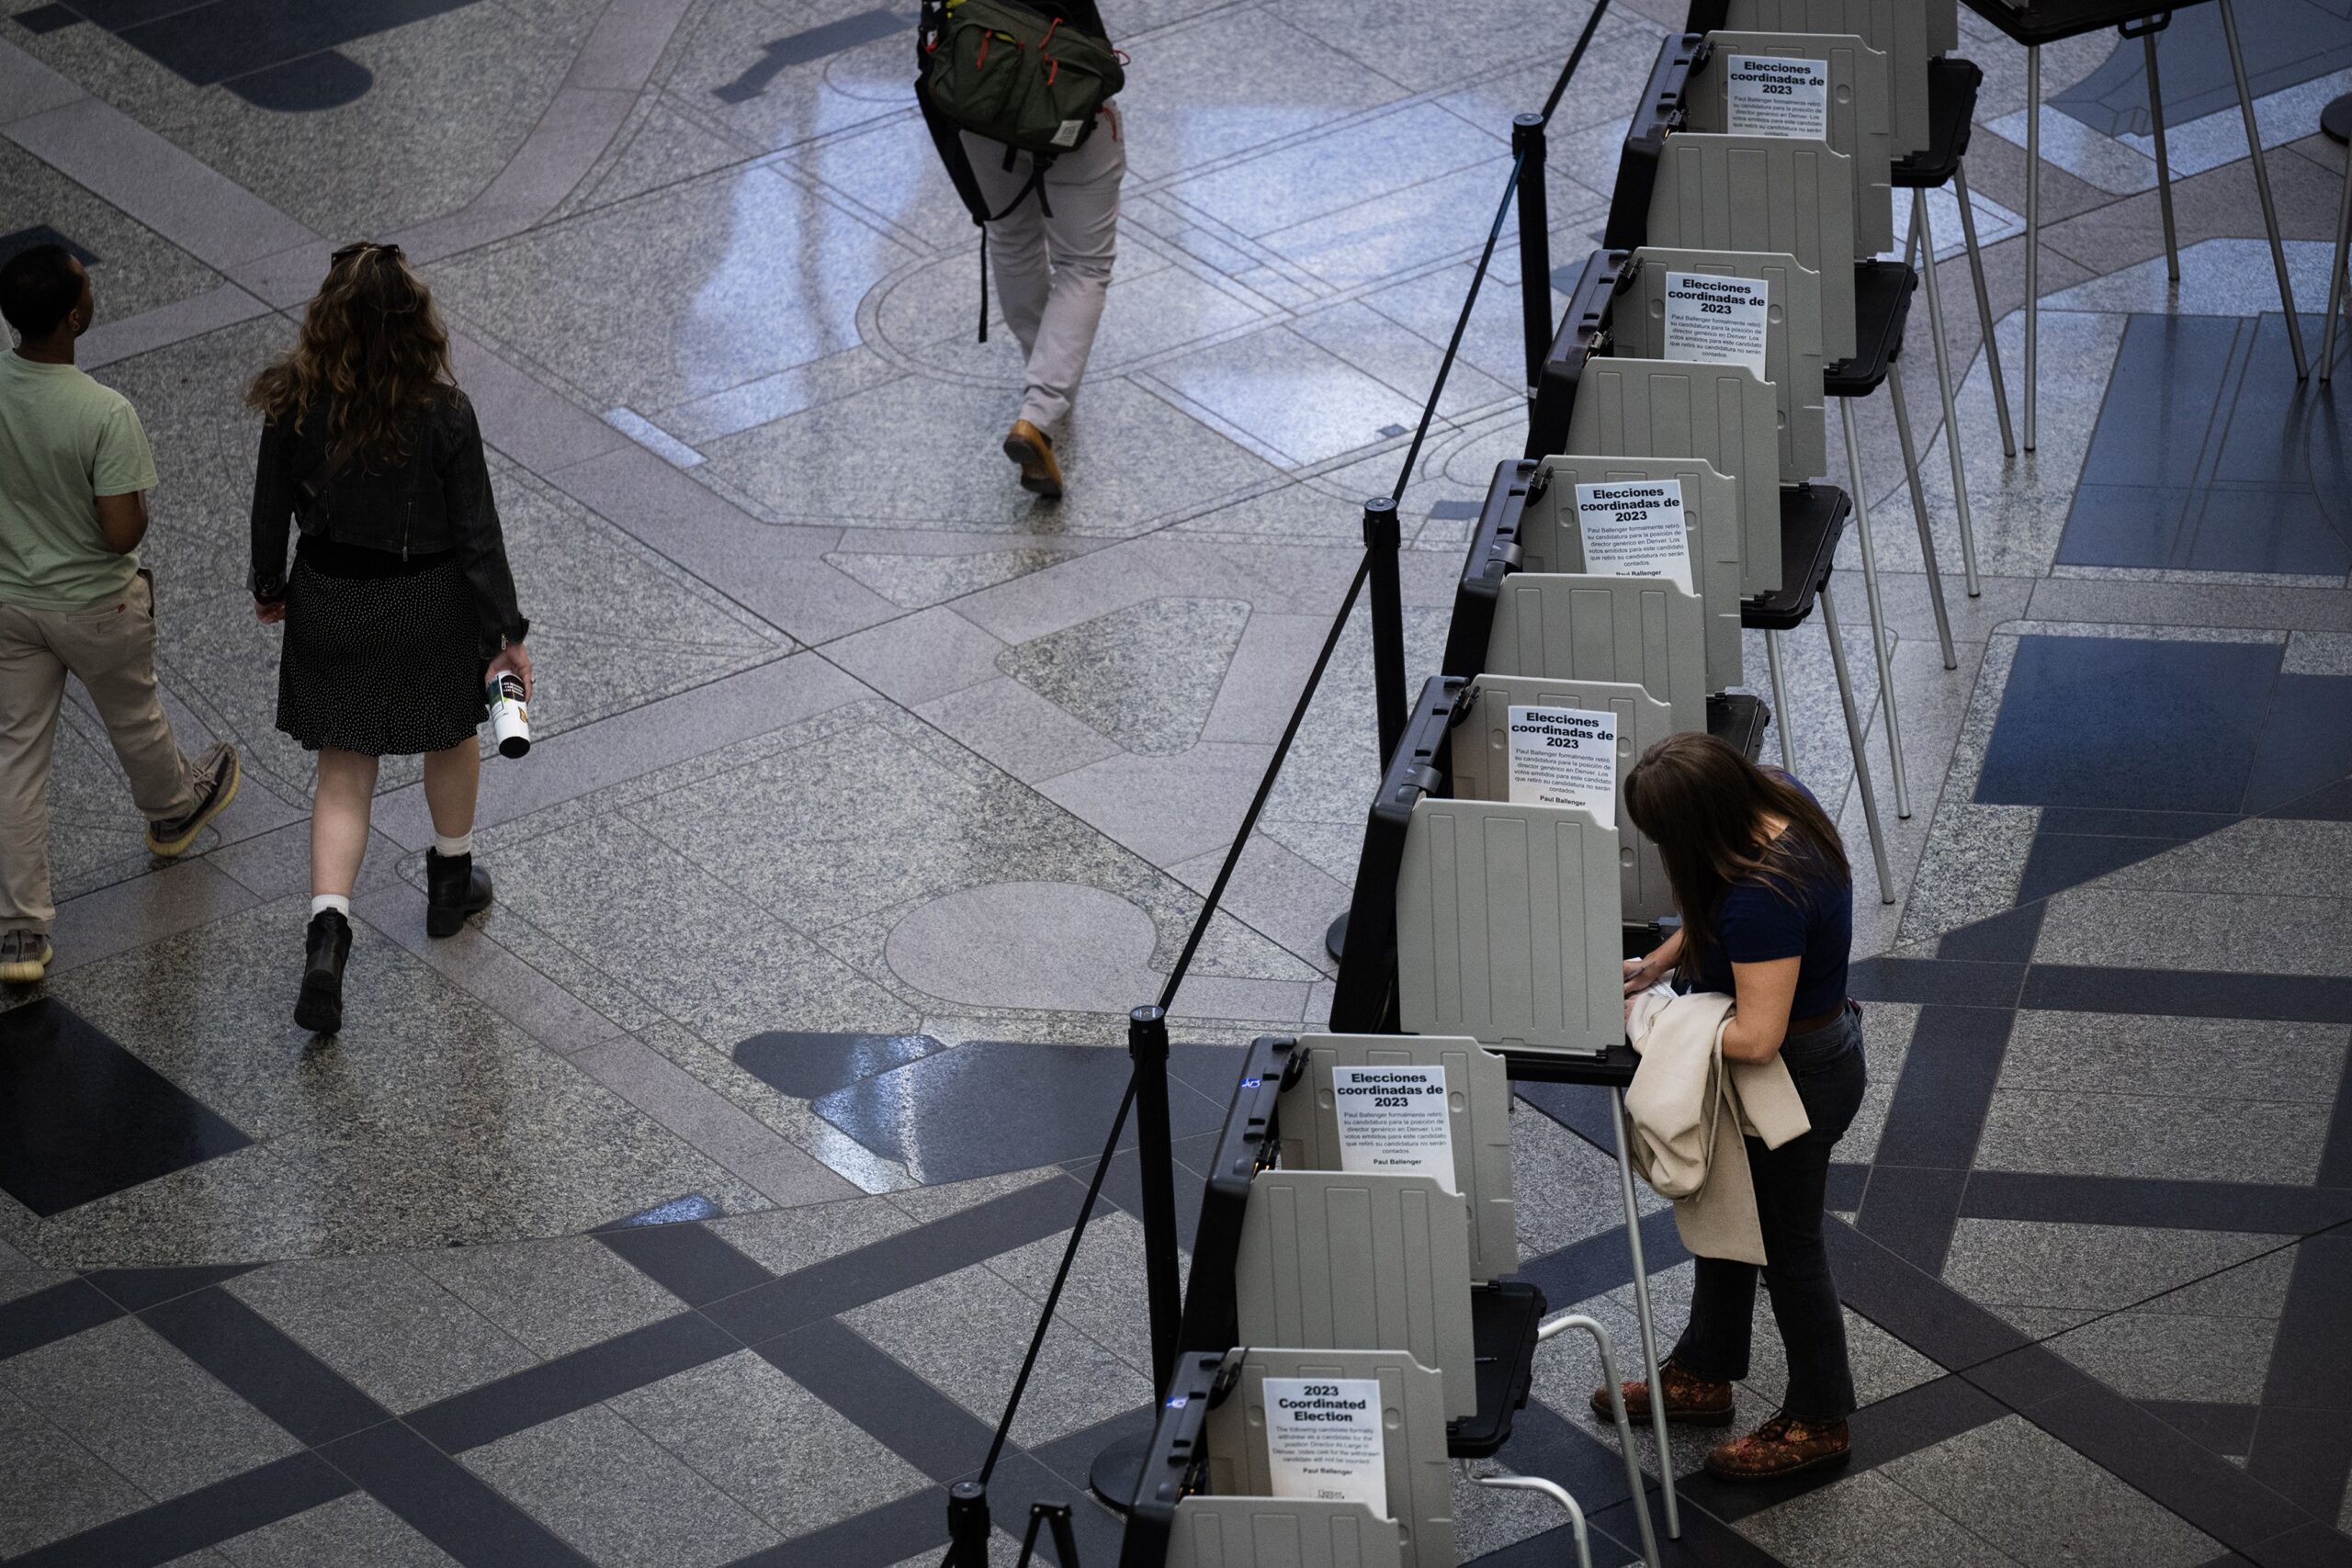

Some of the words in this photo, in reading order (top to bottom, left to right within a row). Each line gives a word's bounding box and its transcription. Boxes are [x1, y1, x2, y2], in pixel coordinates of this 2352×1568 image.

[1744, 62, 1812, 73] Elecciones
[1730, 73, 1806, 85] coordinadas
[1808, 76, 1825, 85] de
[1762, 85, 1792, 95] 2023
[1682, 279, 1752, 294] Elecciones
[1668, 291, 1746, 305] coordinadas
[1748, 297, 1765, 306] de
[1701, 303, 1733, 314] 2023
[1592, 489, 1665, 499] Elecciones
[1580, 500, 1660, 511] coordinadas
[1663, 498, 1680, 507] de
[1614, 512, 1647, 522] 2023
[1526, 713, 1600, 728] Elecciones
[1511, 725, 1594, 739] coordinadas
[1597, 730, 1614, 740] de
[1546, 738, 1579, 749] 2023
[1555, 796, 1587, 807] Ballenger
[1351, 1074, 1427, 1083] Elecciones
[1337, 1086, 1422, 1095] coordinadas
[1426, 1085, 1443, 1094] de
[1374, 1098, 1408, 1107] 2023
[1304, 1386, 1339, 1396] 2023
[1279, 1399, 1366, 1409] Coordinated
[1294, 1412, 1352, 1422] Election
